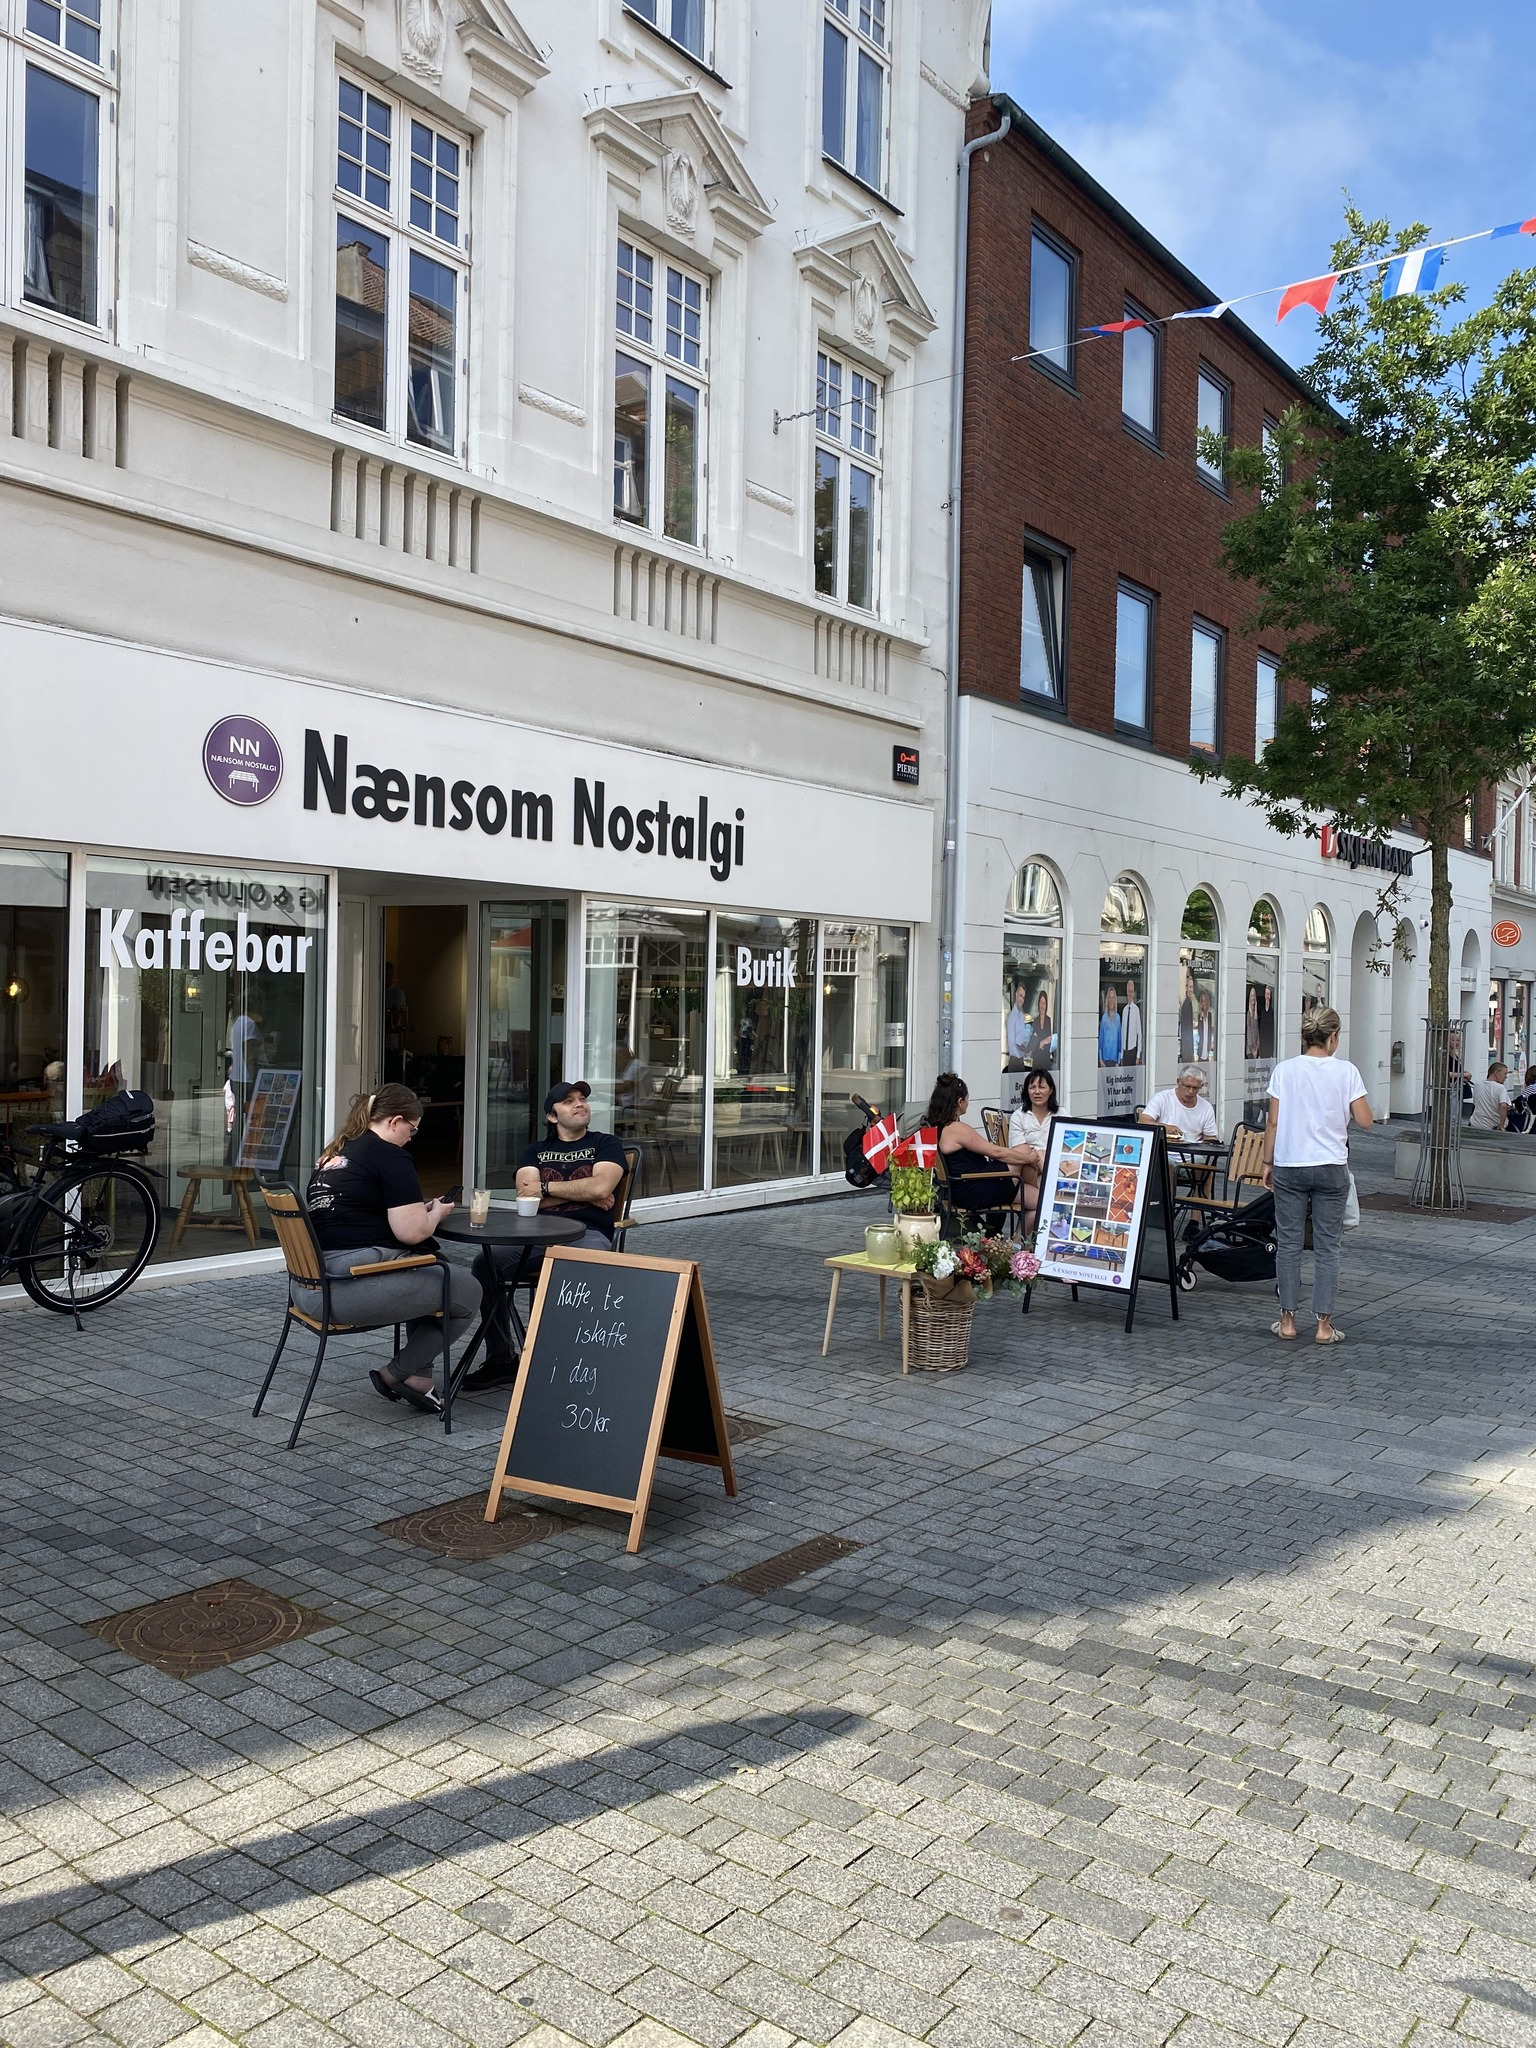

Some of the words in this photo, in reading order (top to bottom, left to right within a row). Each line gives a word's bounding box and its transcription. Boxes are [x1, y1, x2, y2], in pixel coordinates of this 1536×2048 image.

[210, 754, 244, 767] NÆNSOM
[244, 761, 277, 772] NOSTALGI
[229, 735, 260, 758] NN
[303, 728, 553, 842] Nænsom
[573, 776, 745, 882] Nostalgi
[99, 907, 313, 973] Kaffebar
[736, 946, 796, 988] Butik
[1106, 1076, 1114, 1086] Kig
[556, 1279, 595, 1312] Kaffe,
[603, 1284, 624, 1311] te
[575, 1319, 628, 1348] iskaffe
[550, 1358, 558, 1383] i
[569, 1358, 598, 1395] dag
